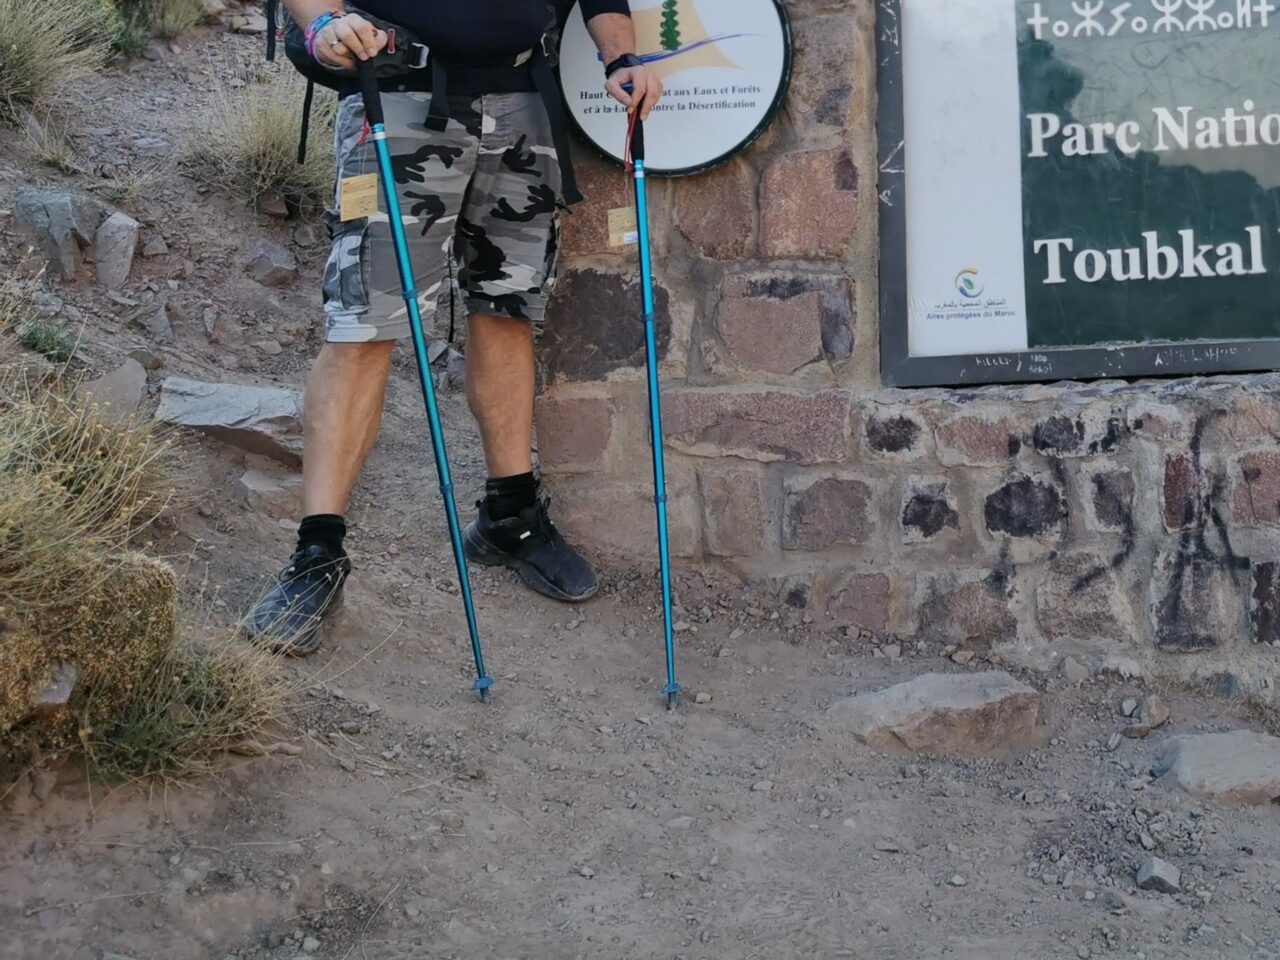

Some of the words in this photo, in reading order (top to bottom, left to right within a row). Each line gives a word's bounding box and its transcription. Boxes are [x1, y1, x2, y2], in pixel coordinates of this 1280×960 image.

[580, 91, 603, 100] Haut
[673, 89, 690, 97] aux
[694, 87, 717, 96] Eaux
[720, 87, 729, 95] et
[731, 84, 761, 95] Forêts
[583, 105, 592, 114] et
[677, 101, 686, 111] la
[688, 99, 756, 111] Désertification
[1026, 113, 1142, 157] Parc
[1033, 225, 1268, 284] Toubkal
[946, 311, 981, 321] protégées
[994, 310, 1016, 318] Maroc
